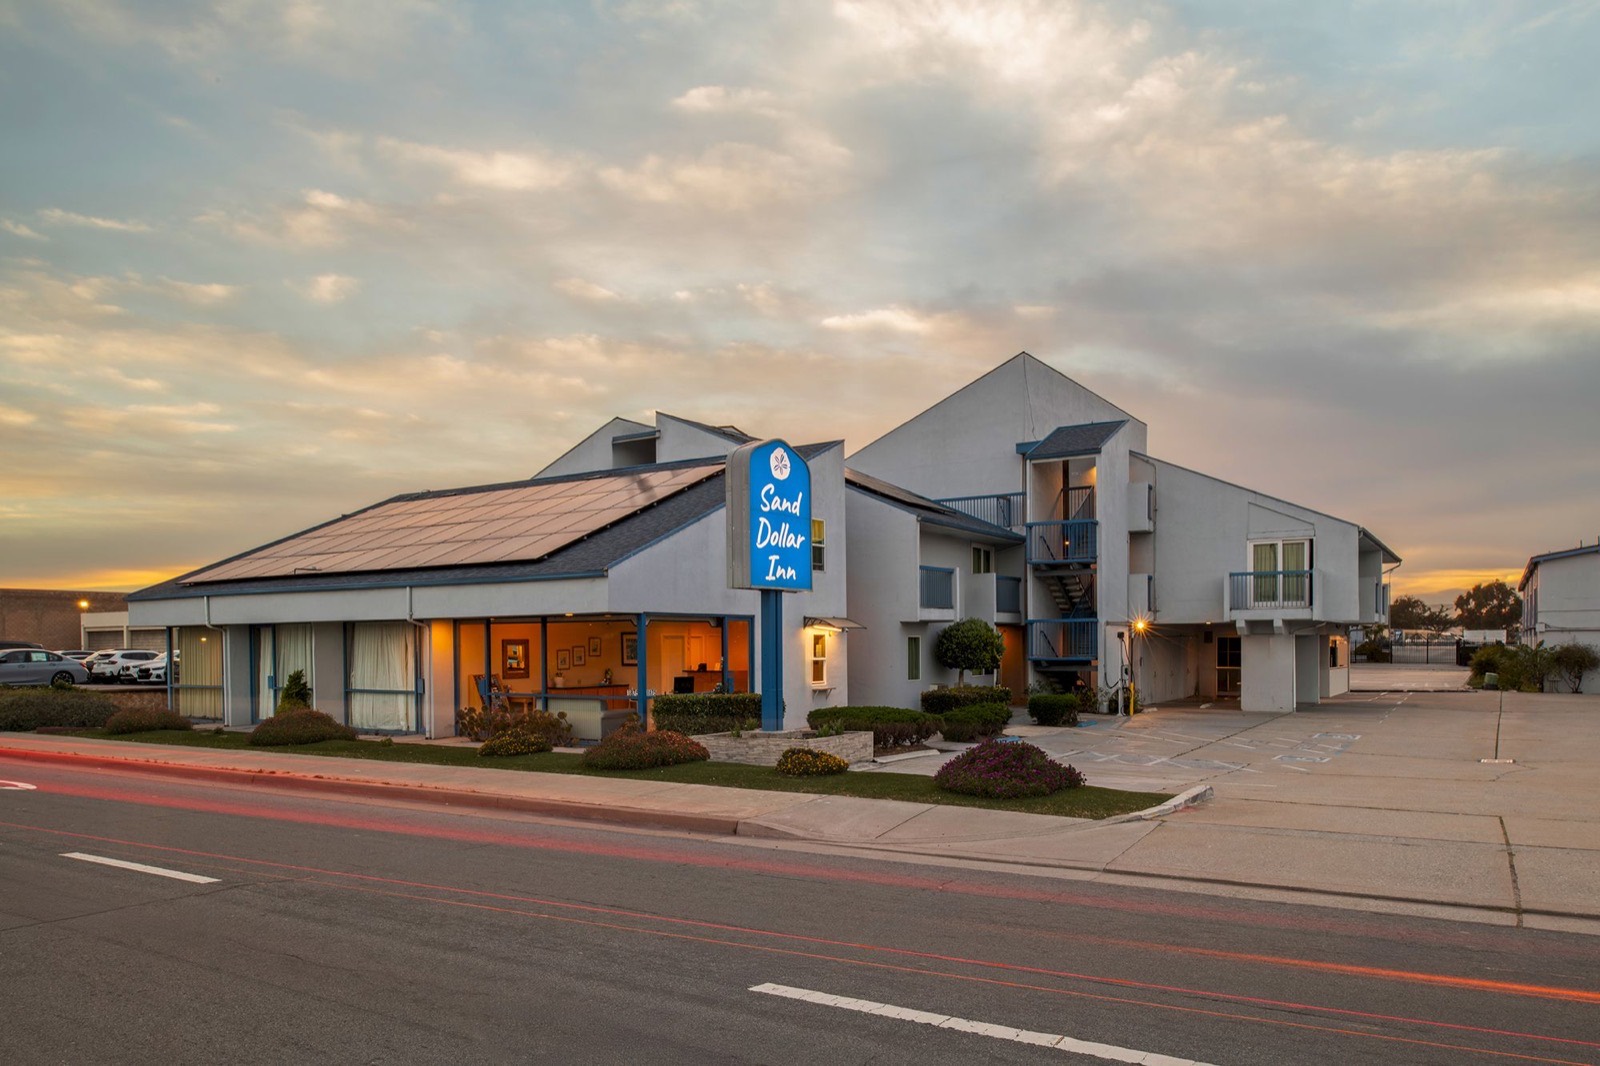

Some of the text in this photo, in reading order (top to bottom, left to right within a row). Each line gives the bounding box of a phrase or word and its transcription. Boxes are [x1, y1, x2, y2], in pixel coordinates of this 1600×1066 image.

[760, 483, 803, 516] Sand
[756, 517, 806, 549] Dollar
[765, 555, 797, 581] Inn
